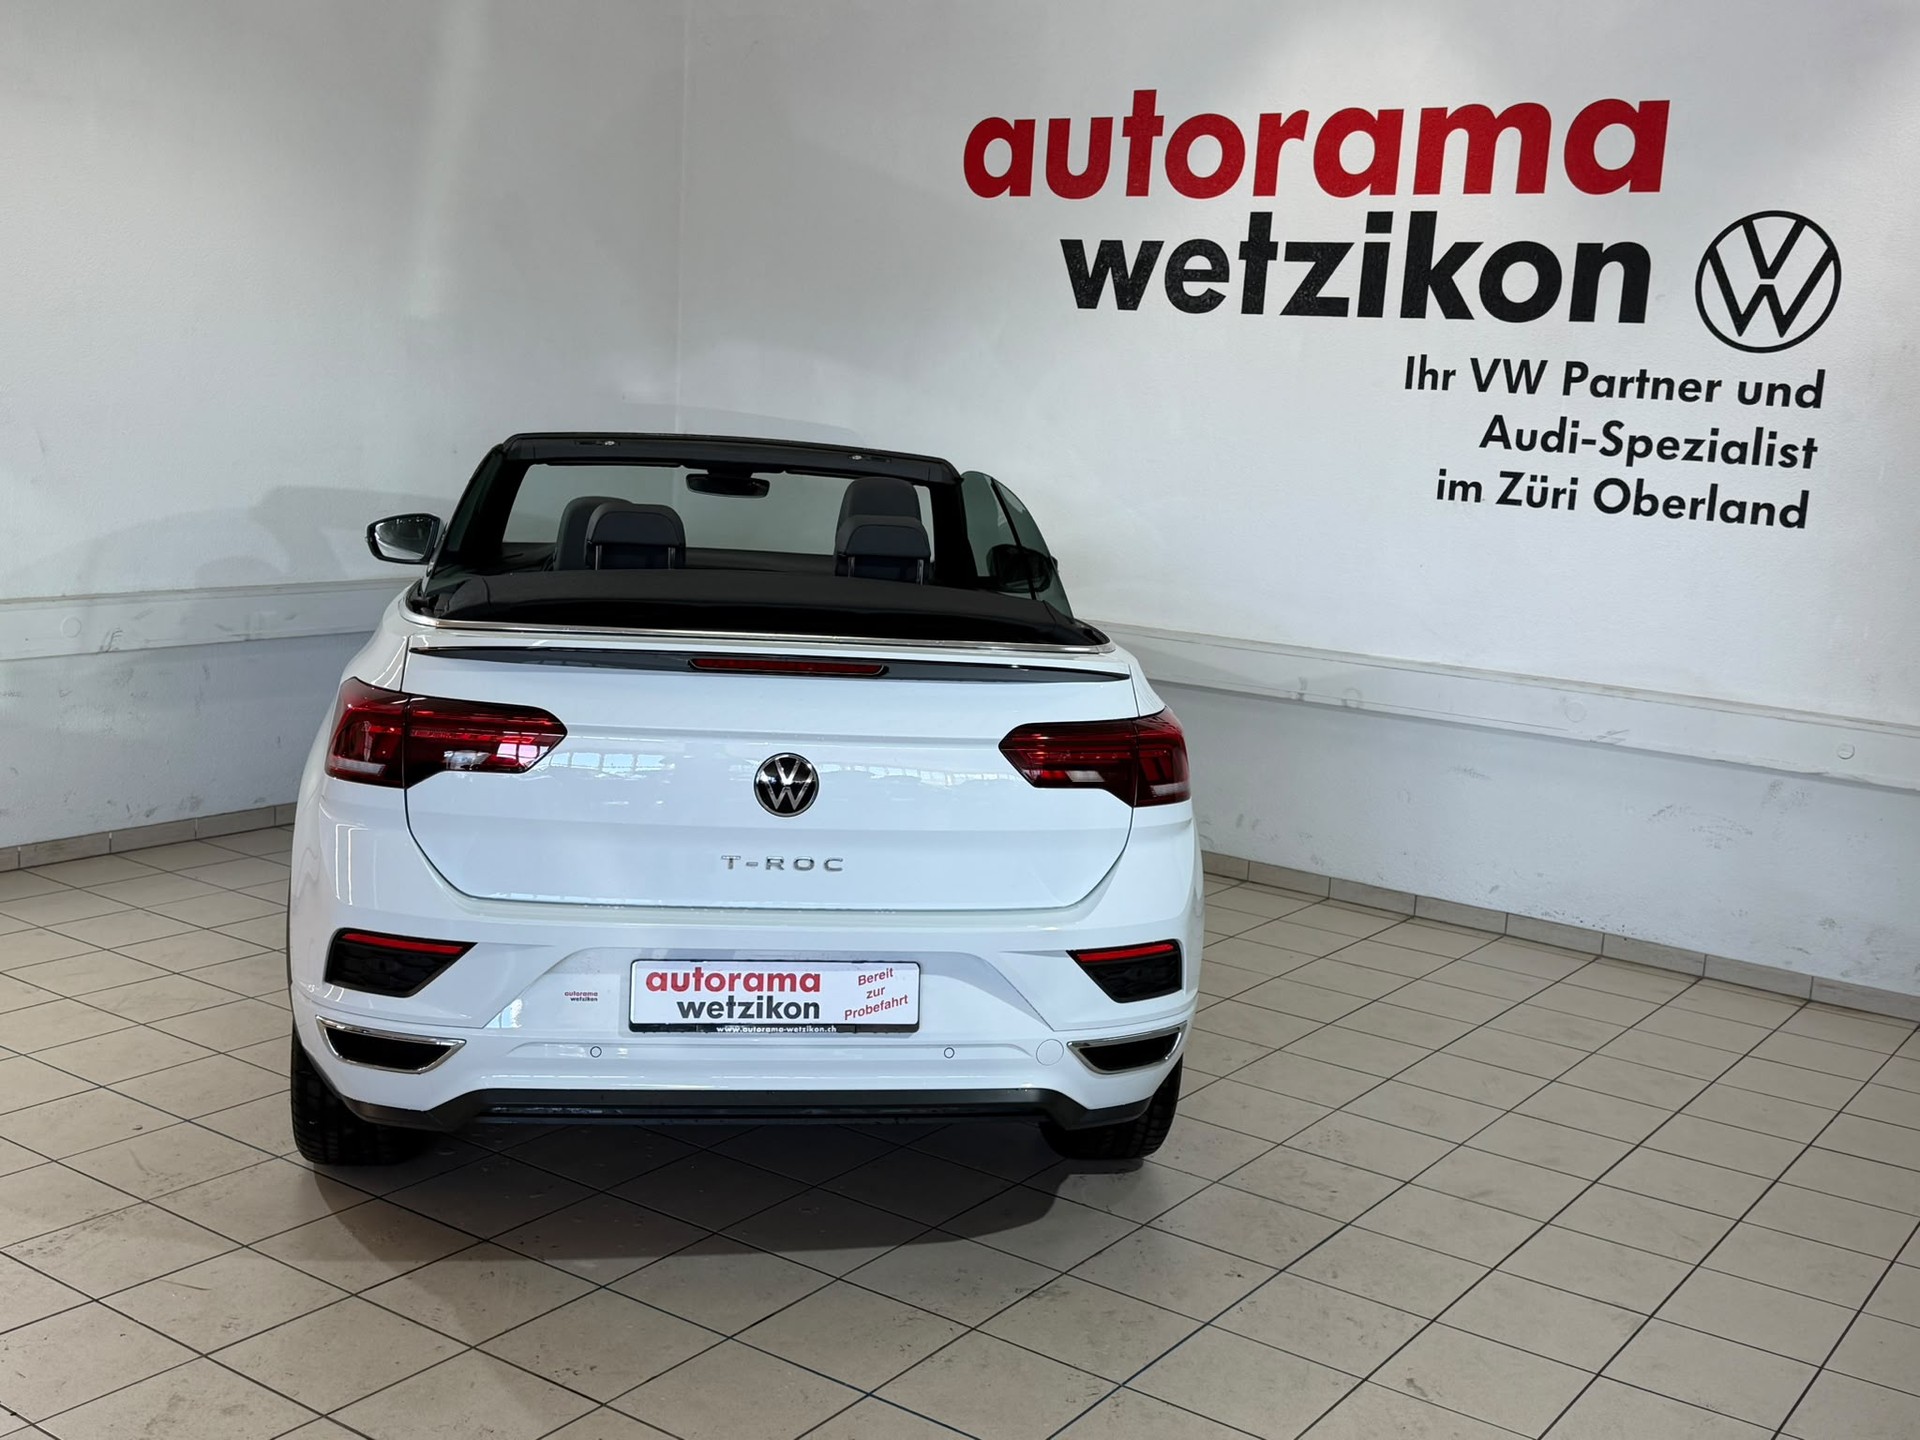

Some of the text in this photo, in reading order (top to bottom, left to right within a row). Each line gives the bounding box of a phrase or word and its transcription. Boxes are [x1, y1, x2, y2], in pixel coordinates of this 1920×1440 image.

[965, 91, 1669, 199] autorama
[1059, 210, 1651, 324] wetzikon
[1404, 354, 1826, 409] Ihr VW Partner und
[1478, 414, 1818, 469] Audi-Spezialist
[1436, 468, 1810, 529] im Züri Oberland
[721, 855, 844, 872] T-ROC
[646, 967, 821, 993] autorama
[858, 967, 893, 986] Bereit
[866, 986, 885, 999] zur
[676, 995, 820, 1019] wetzikon
[844, 994, 908, 1021] Probefahrt
[716, 1025, 837, 1033] www.autorama-wetzikon.ch
